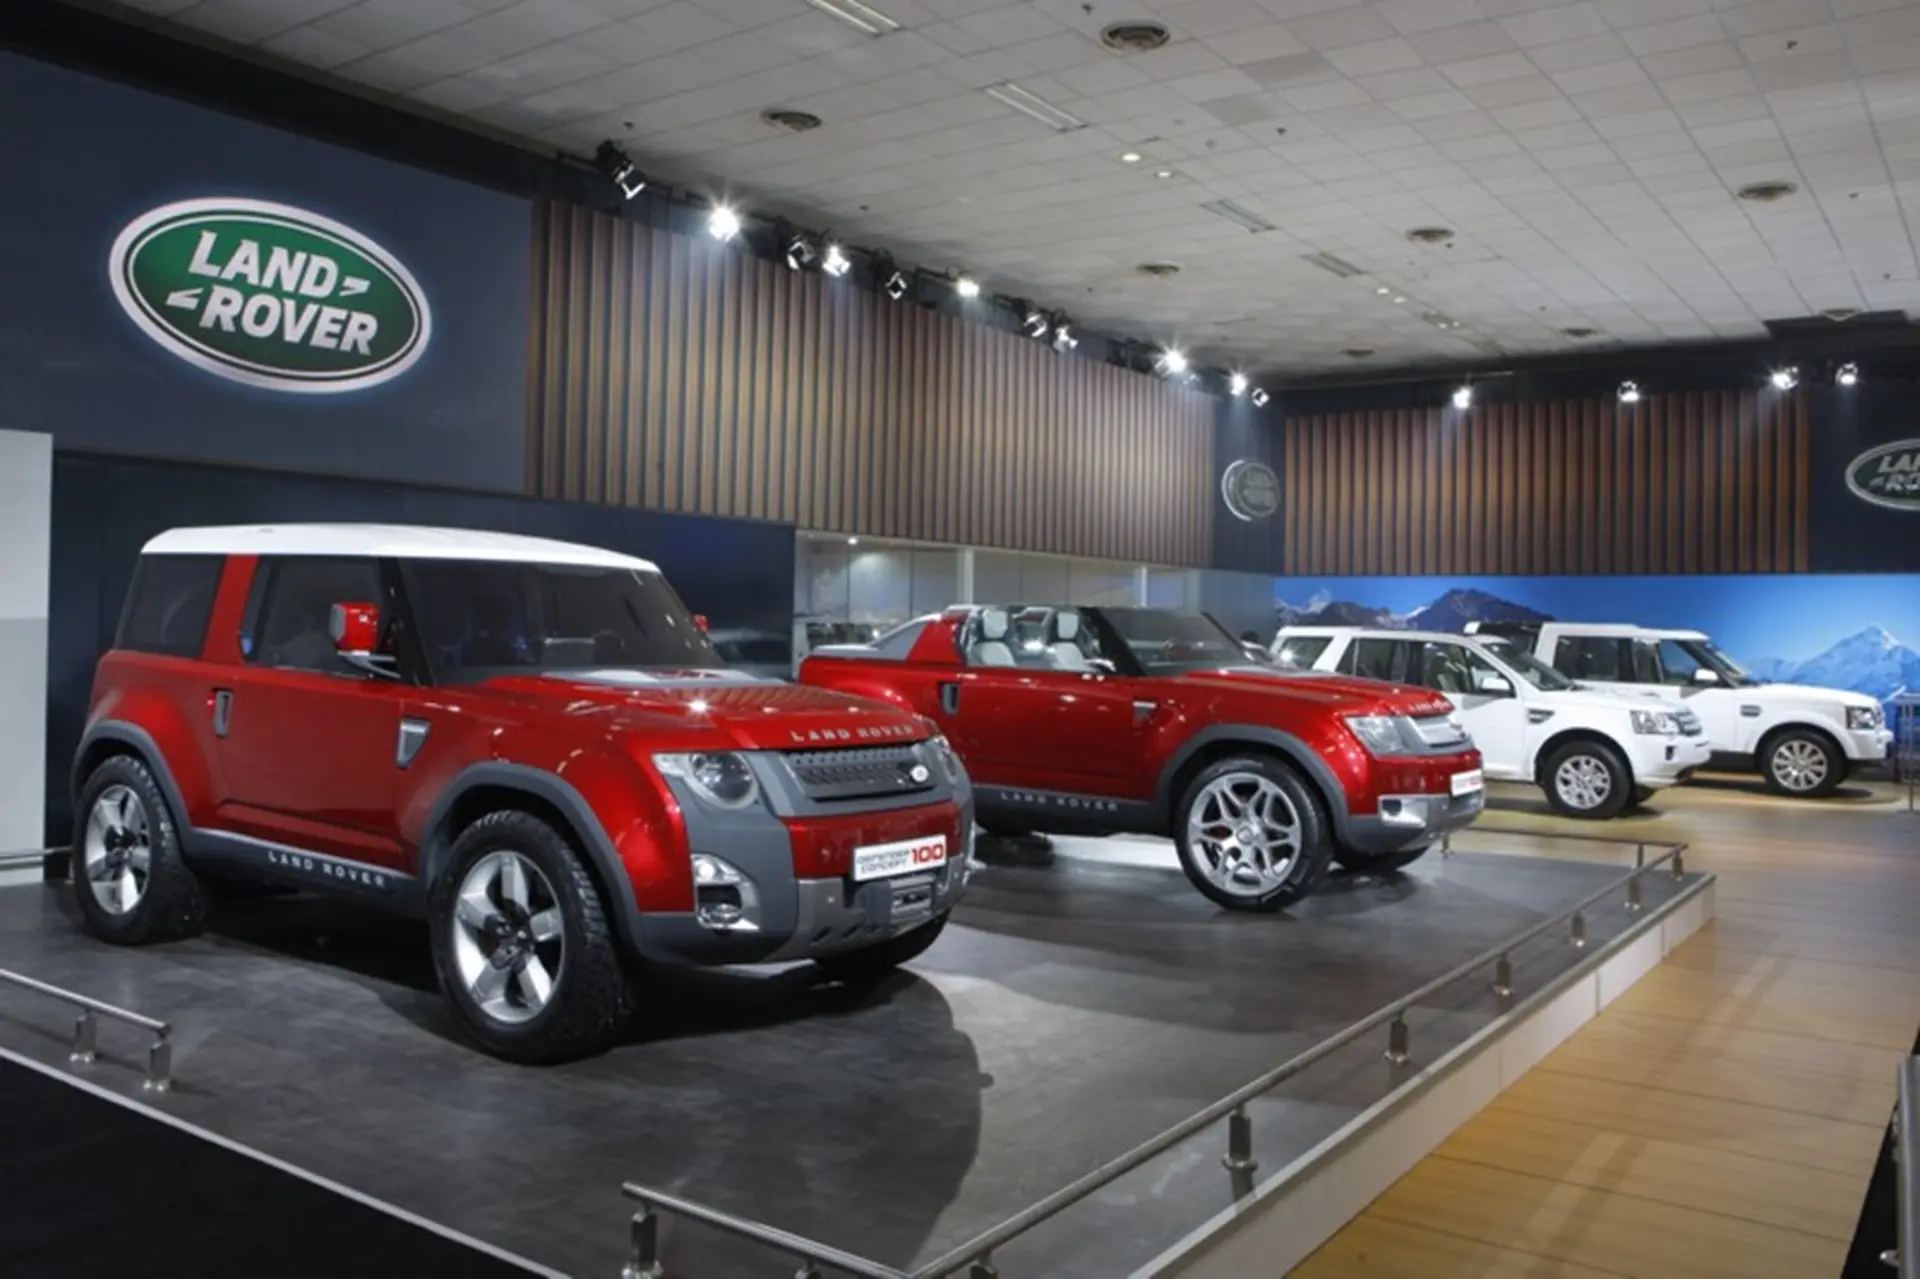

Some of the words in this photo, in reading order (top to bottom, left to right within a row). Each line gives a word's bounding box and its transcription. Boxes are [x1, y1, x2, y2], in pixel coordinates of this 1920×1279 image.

[189, 230, 338, 298] LAND
[200, 285, 378, 355] ROVER
[791, 729, 851, 742] LAND
[857, 725, 914, 738] ROVER
[1000, 791, 1047, 805] LAND
[1056, 798, 1118, 812] ROVER
[267, 850, 314, 871] LAND
[322, 863, 385, 887] ROVER
[911, 844, 944, 864] 100
